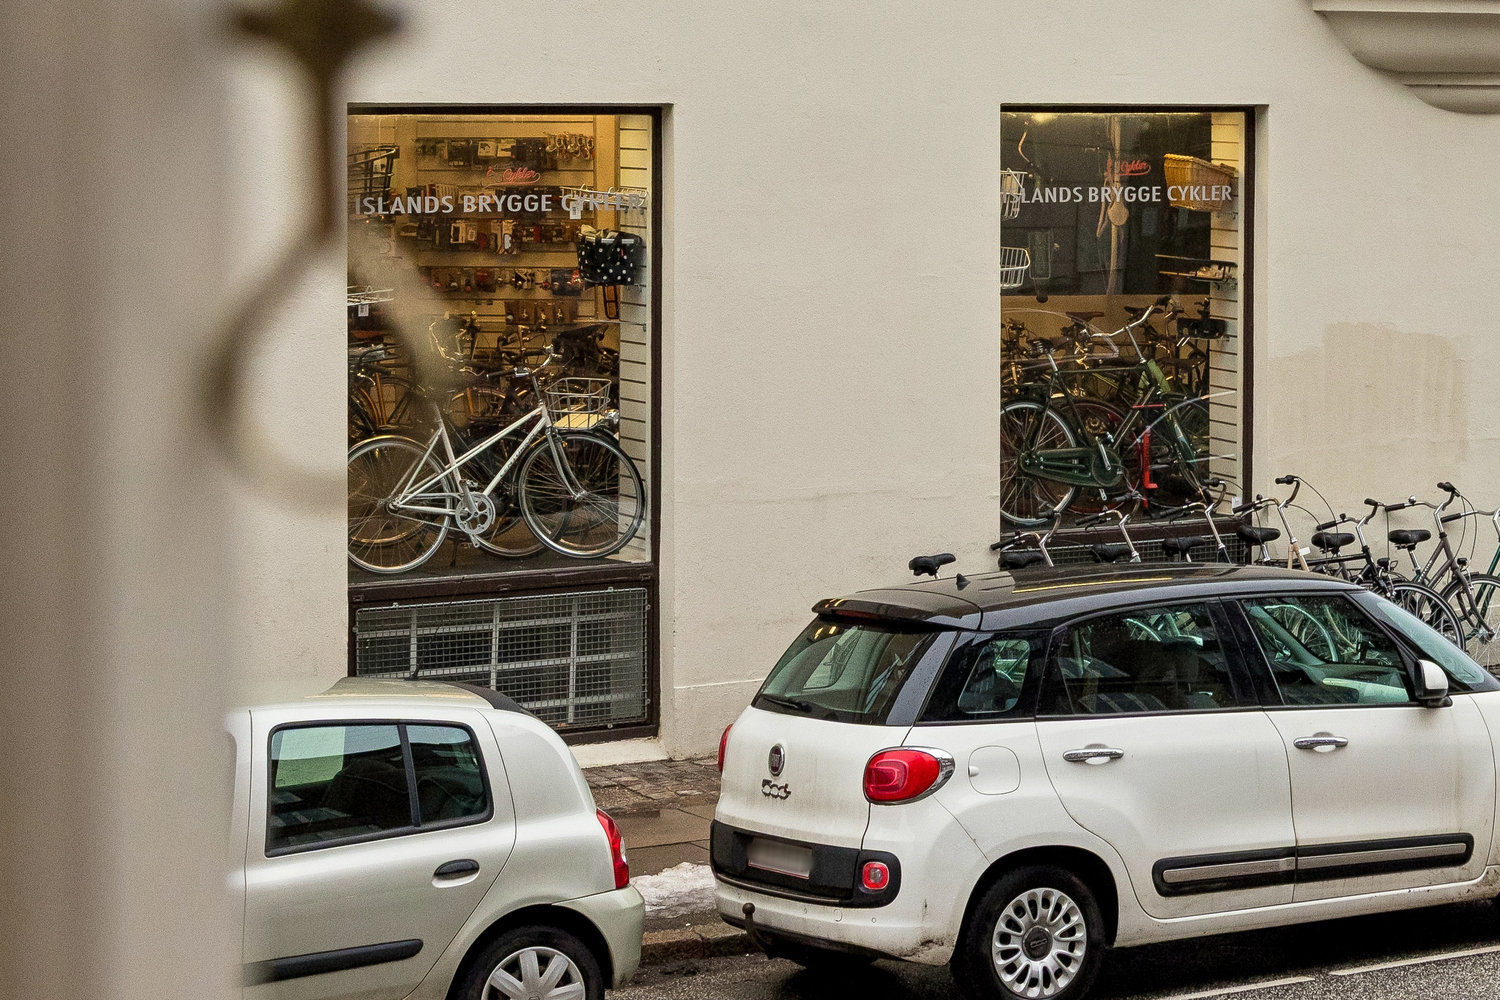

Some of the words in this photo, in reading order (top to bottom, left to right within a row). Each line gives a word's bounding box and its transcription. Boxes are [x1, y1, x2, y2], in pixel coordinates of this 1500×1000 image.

[355, 195, 454, 215] ISLANDS
[463, 194, 553, 213] BRYGGE
[561, 193, 642, 212] CYKLER
[1088, 186, 1162, 203] BRYGGE
[1166, 185, 1232, 201] CYKLER
